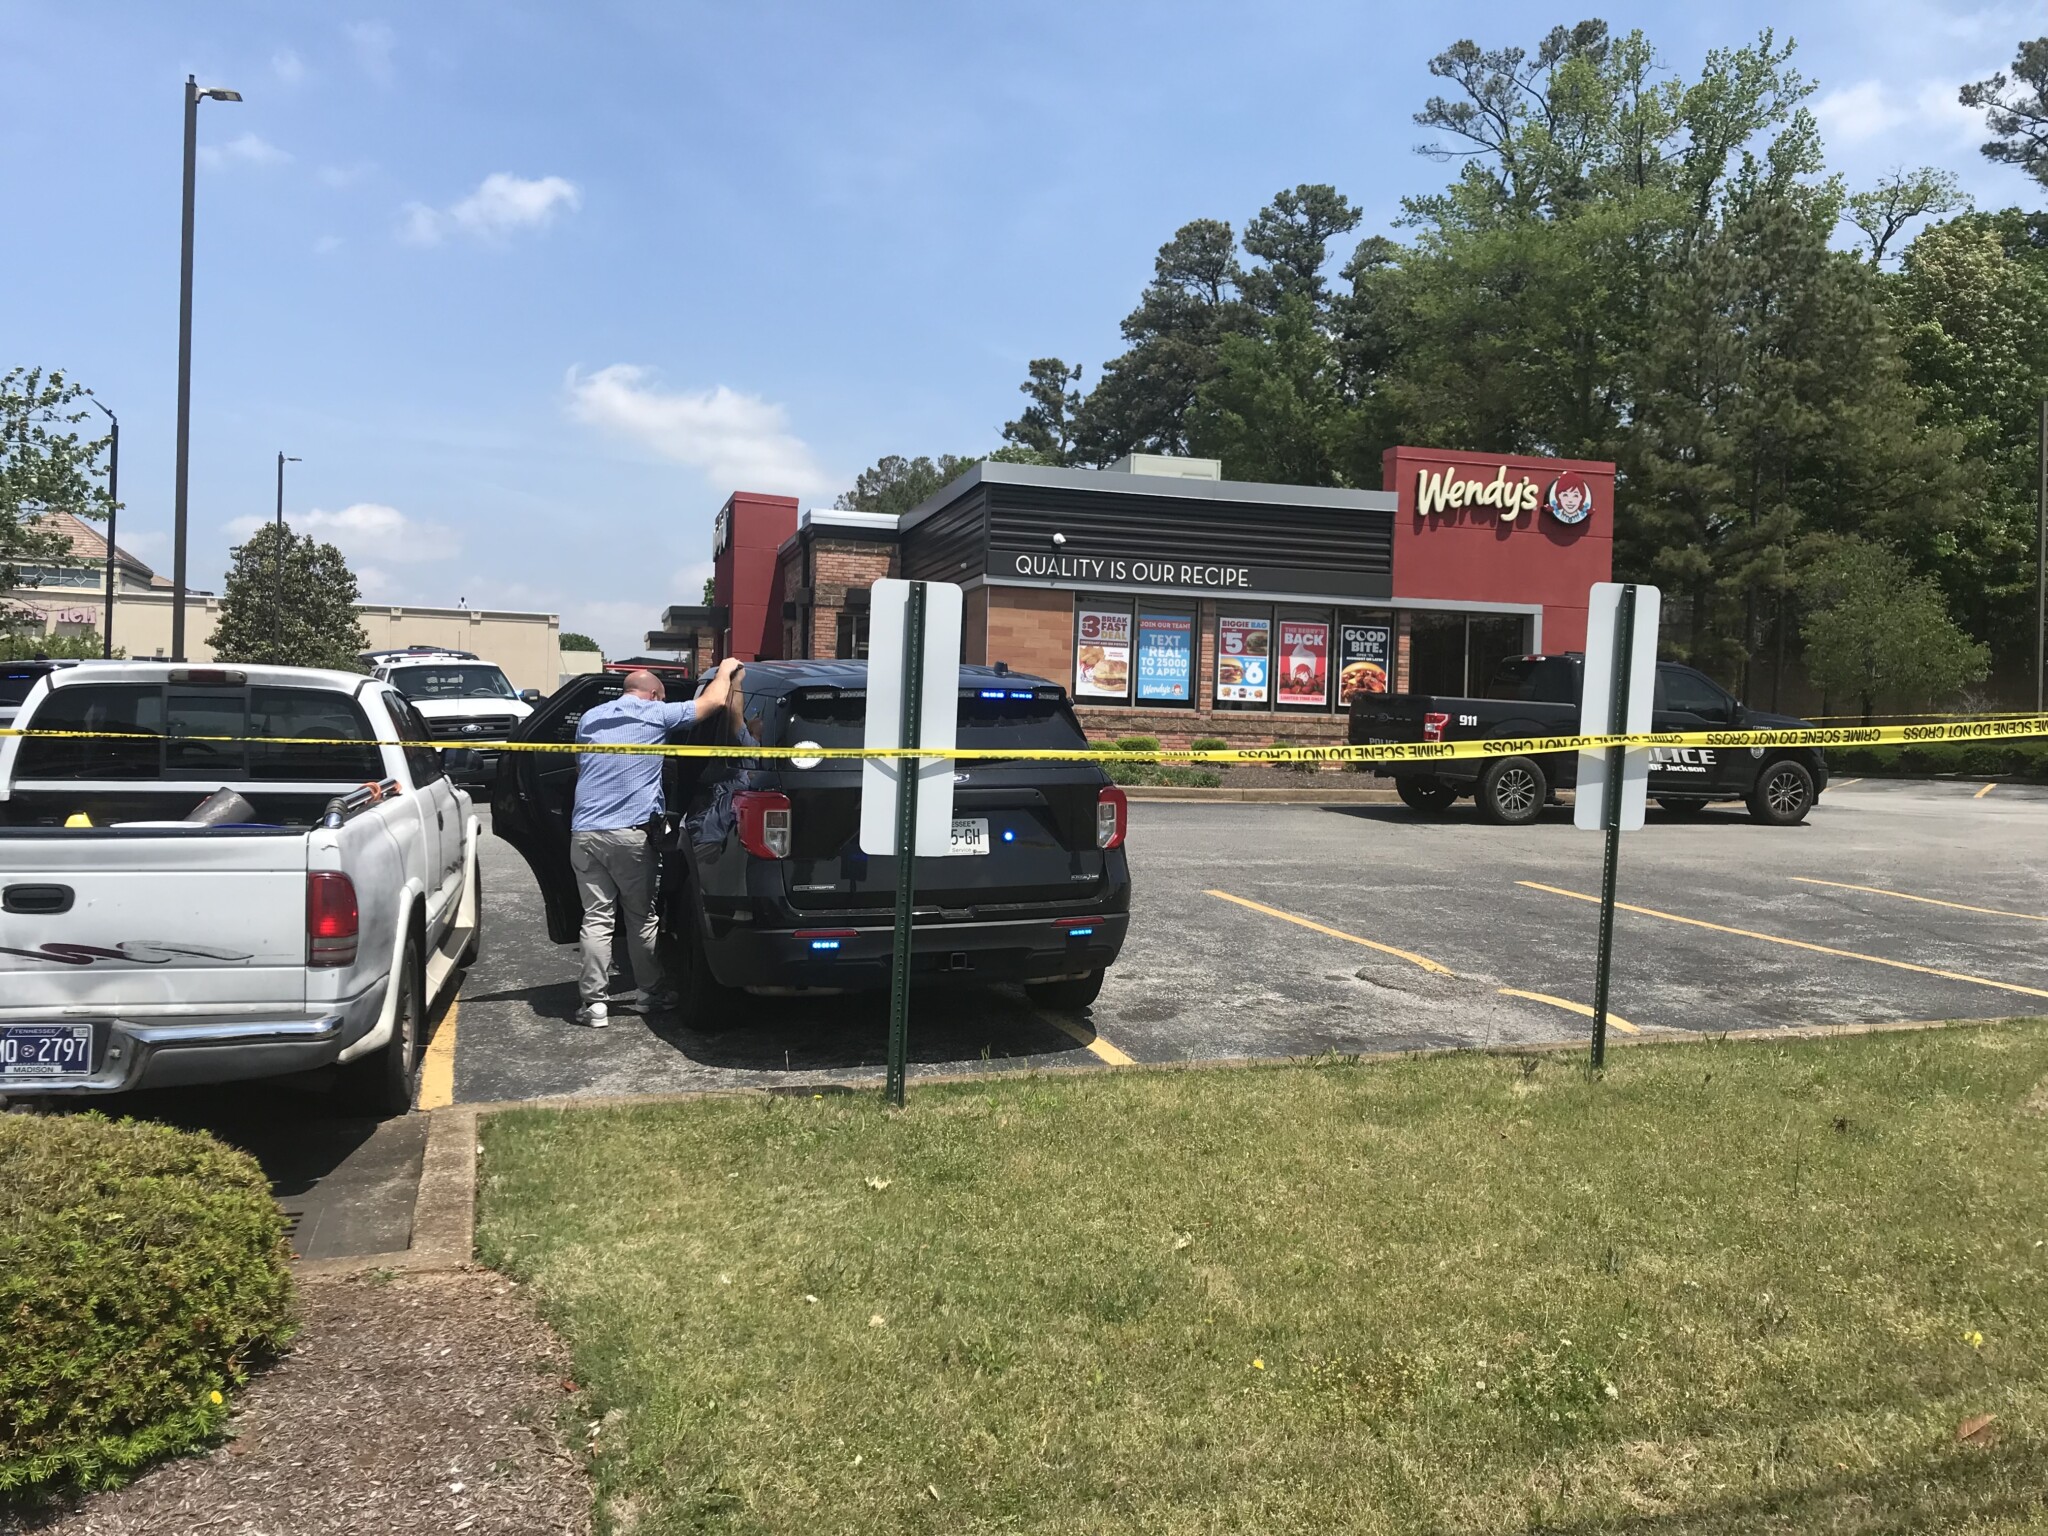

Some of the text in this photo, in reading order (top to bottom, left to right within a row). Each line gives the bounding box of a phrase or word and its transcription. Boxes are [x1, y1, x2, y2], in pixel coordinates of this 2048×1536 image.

[1418, 465, 1539, 521] Wendy's
[1015, 555, 1252, 587] QUALITY IS OUR RECIPE.
[1101, 616, 1128, 624] BREAK
[1101, 622, 1128, 631] FAST
[1221, 620, 1267, 629] BIGGIE BAG
[1101, 630, 1127, 640] DEAL
[1149, 634, 1181, 646] TEXT
[1284, 633, 1324, 646] BACK
[1345, 629, 1386, 642] GOOD
[1351, 641, 1383, 653] BITE.
[1141, 657, 1187, 668] TO 25000
[1141, 667, 1187, 677] TO APPLY
[1142, 683, 1171, 696] Wendy's
[1459, 714, 1478, 726] 911
[1903, 725, 1945, 740] CROSS
[1948, 724, 1972, 738] NOT
[1973, 723, 1991, 736] DO
[1993, 720, 2032, 735] SCENE
[1706, 728, 1881, 746] CRIME SCENE DO NOT CROSS
[1329, 748, 1351, 760] DO
[1355, 746, 1404, 760] SCENE
[1408, 744, 1455, 759] CRIME
[1648, 747, 1717, 765] LICE
[1665, 764, 1707, 773] Jackson
[38, 1038, 87, 1062] 2797
